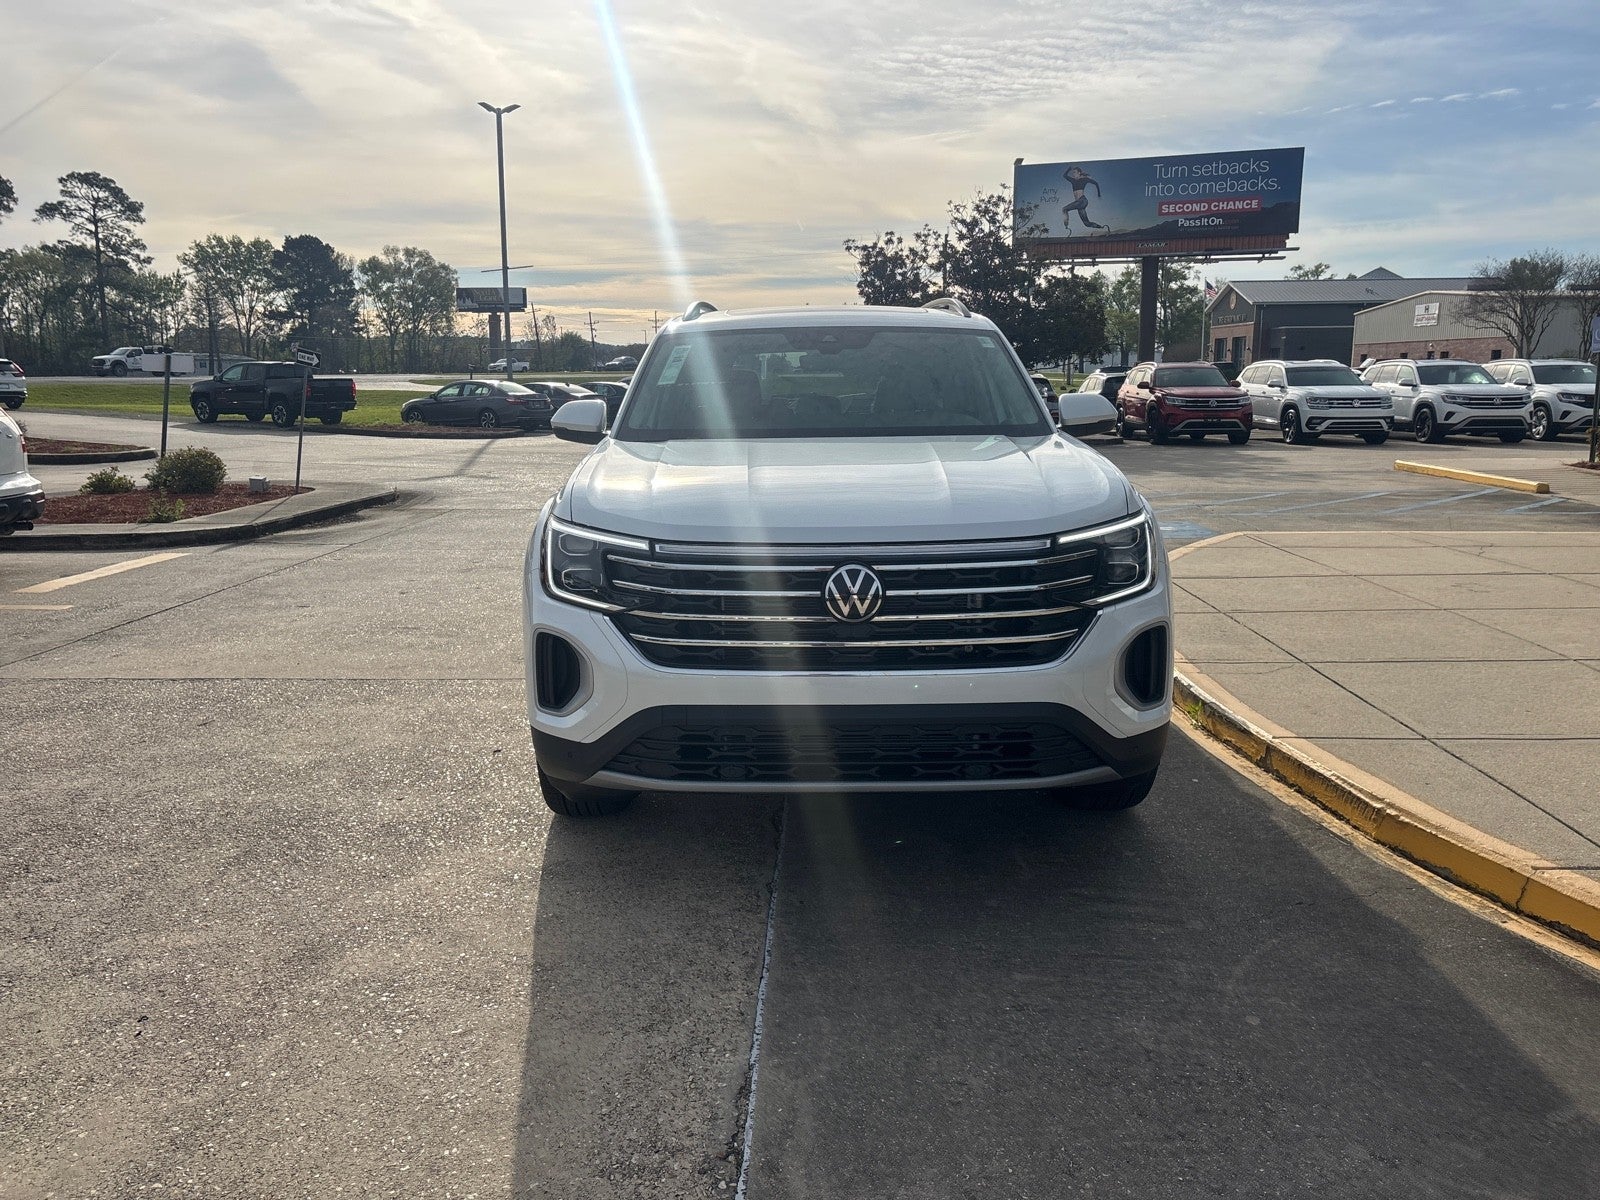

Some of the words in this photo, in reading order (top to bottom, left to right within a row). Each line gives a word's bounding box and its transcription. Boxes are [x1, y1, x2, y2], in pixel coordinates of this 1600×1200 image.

[1153, 163, 1188, 179] Turn
[1191, 158, 1270, 177] setbacks
[1145, 182, 1175, 197] into
[1178, 175, 1281, 196] comebacks.
[1161, 202, 1208, 213] SECOND
[1210, 199, 1259, 210] CHANCE
